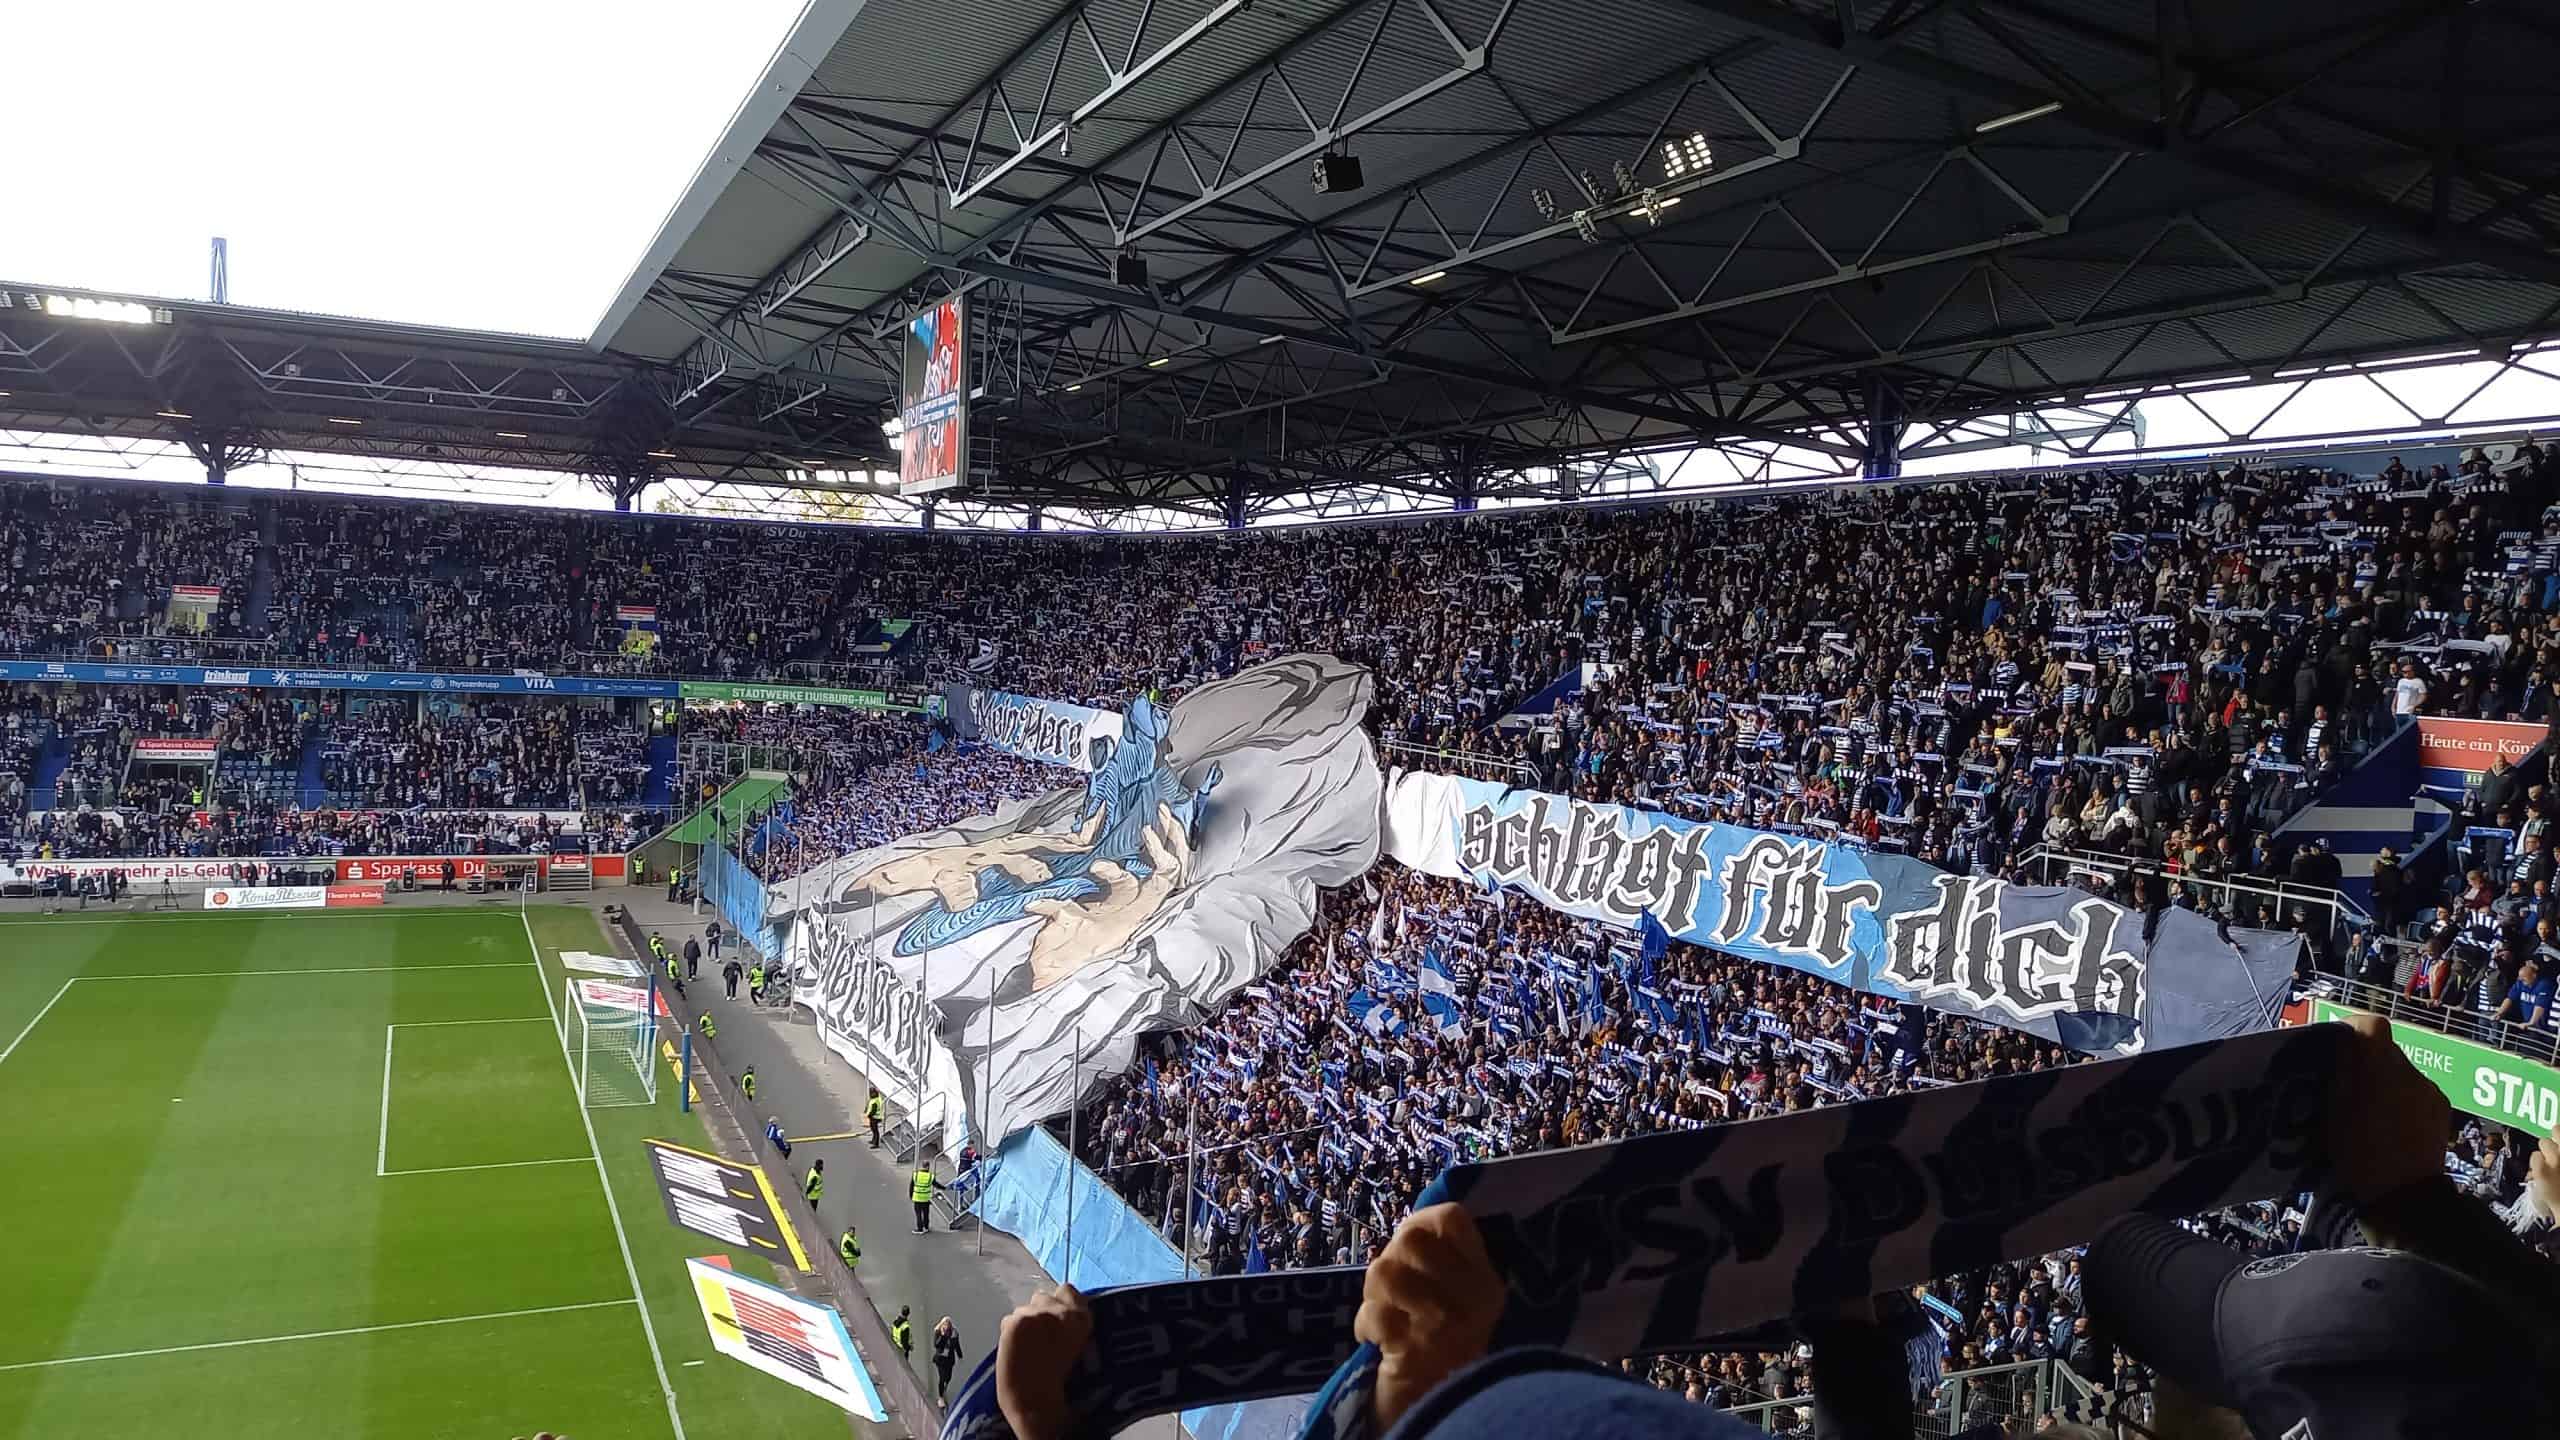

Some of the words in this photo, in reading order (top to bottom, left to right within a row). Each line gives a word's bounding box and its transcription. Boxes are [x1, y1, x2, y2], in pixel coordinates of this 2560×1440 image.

[524, 678, 555, 689] VITA
[731, 687, 803, 701] STADTWERKE
[2420, 733, 2466, 750] Heute
[2469, 738, 2492, 751] ein
[165, 864, 189, 877] als
[1460, 796, 1714, 933] schlägt
[1713, 834, 1885, 967] für
[1886, 874, 2147, 1054] dich
[2472, 1066, 2559, 1131] STAD
[1475, 1162, 1786, 1306] MSV
[1822, 1071, 2336, 1244] Duisburg
